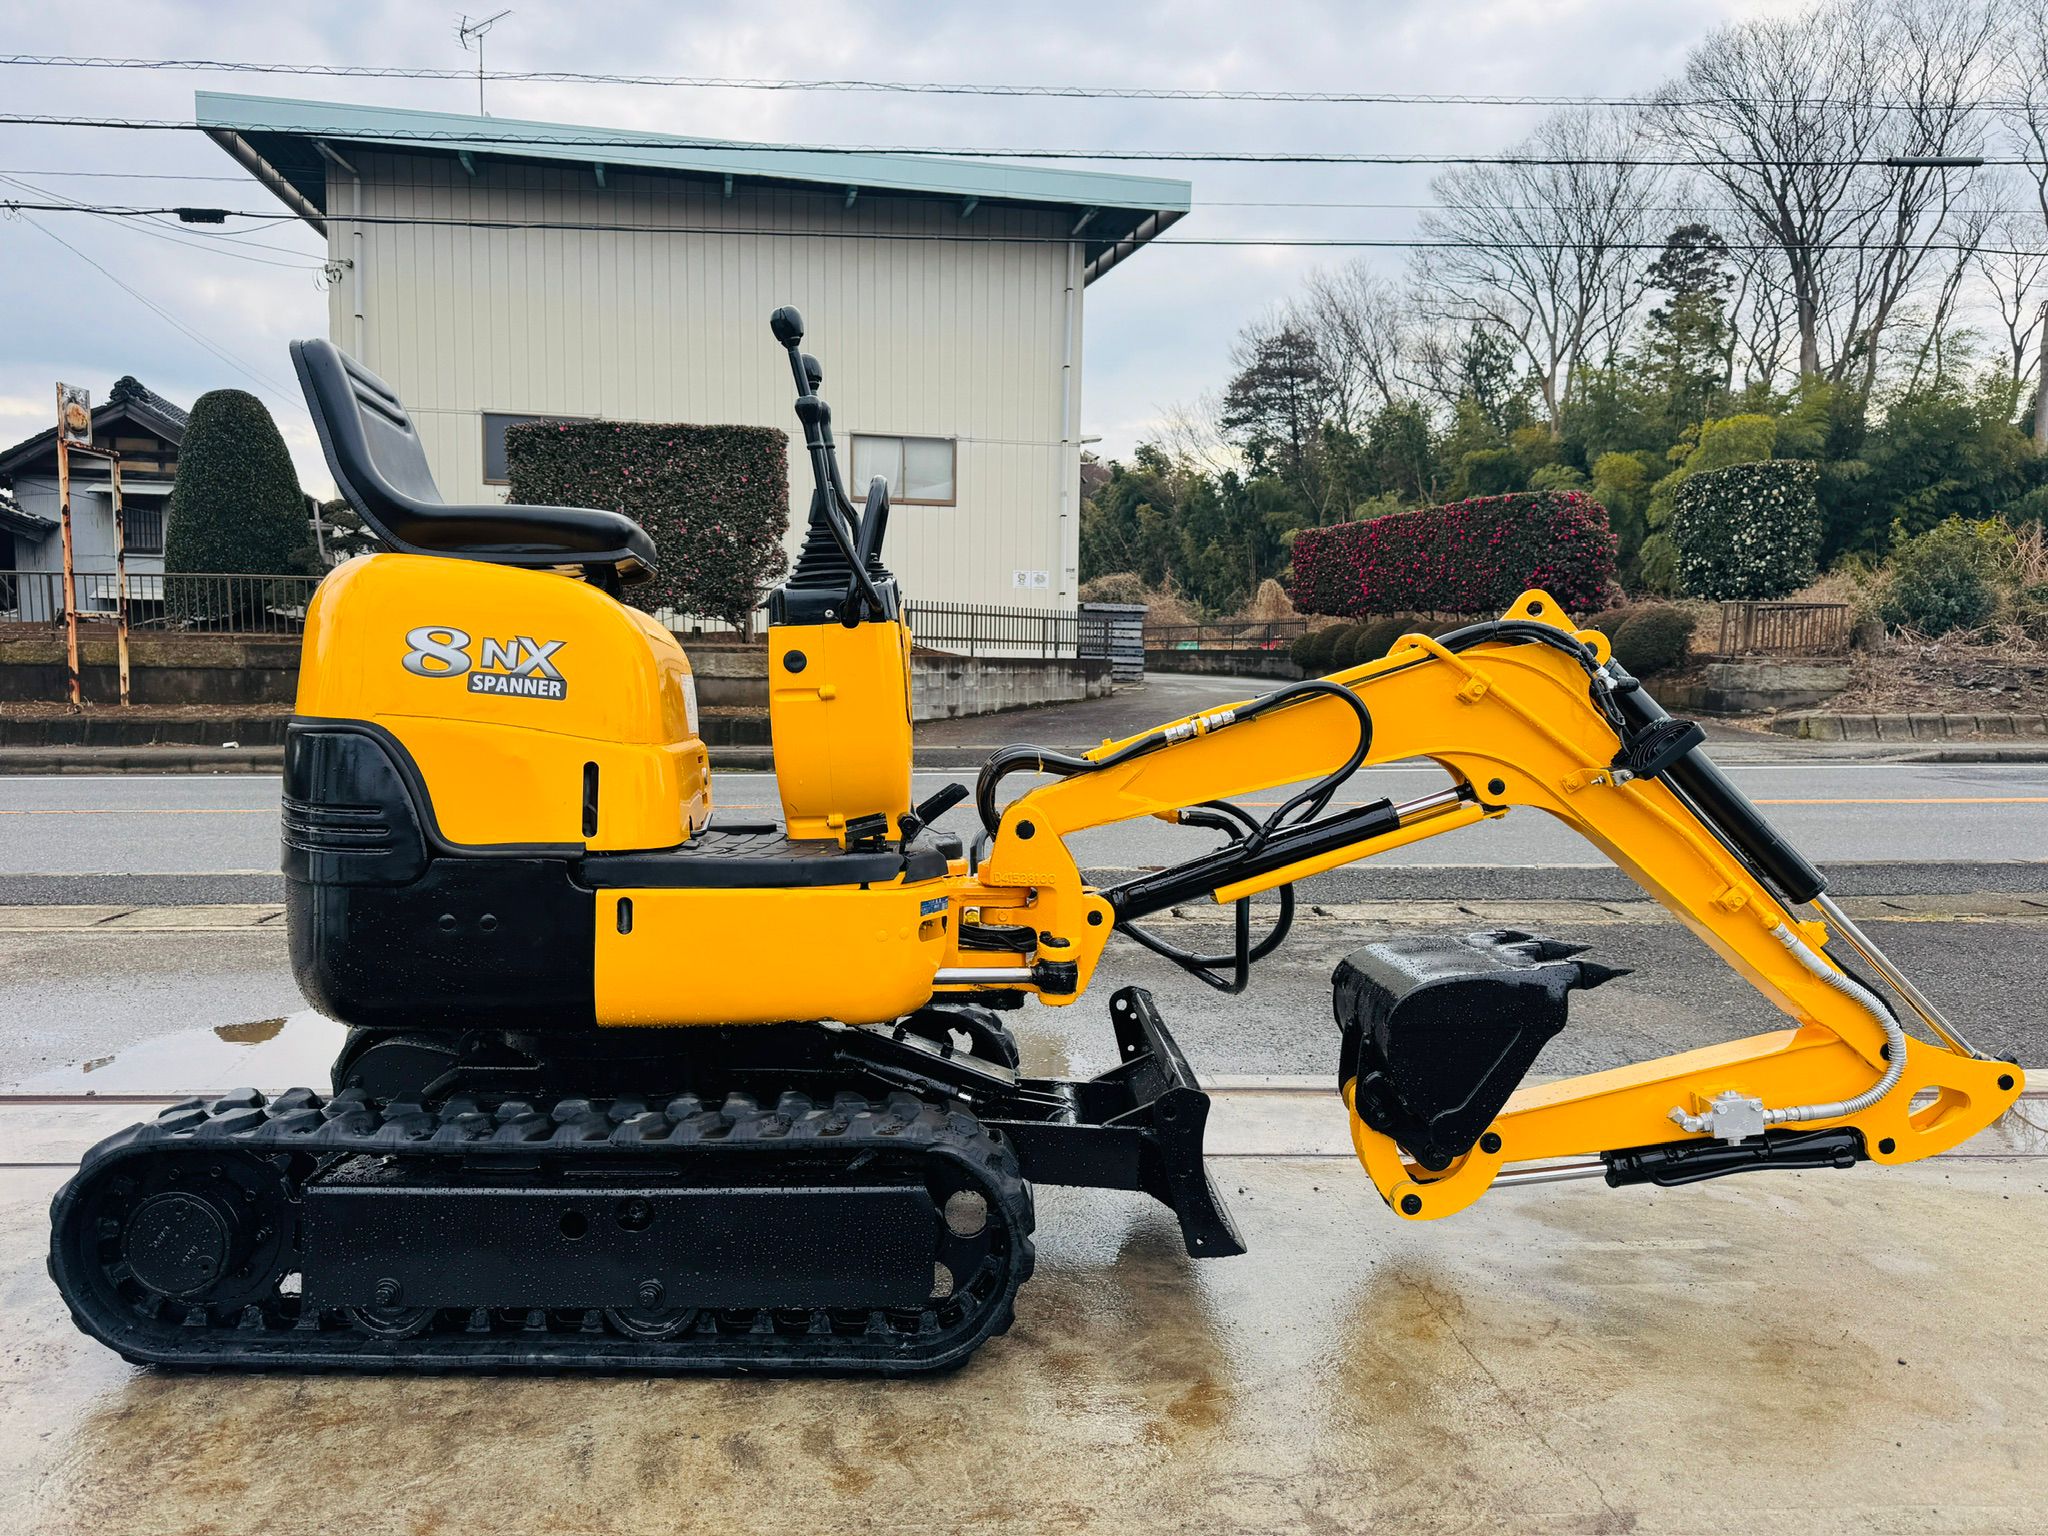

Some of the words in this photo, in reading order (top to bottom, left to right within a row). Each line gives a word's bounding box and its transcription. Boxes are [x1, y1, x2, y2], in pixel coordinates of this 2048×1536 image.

[402, 626, 472, 678] 8
[480, 635, 567, 681] NX
[472, 674, 562, 697] SPANNER
